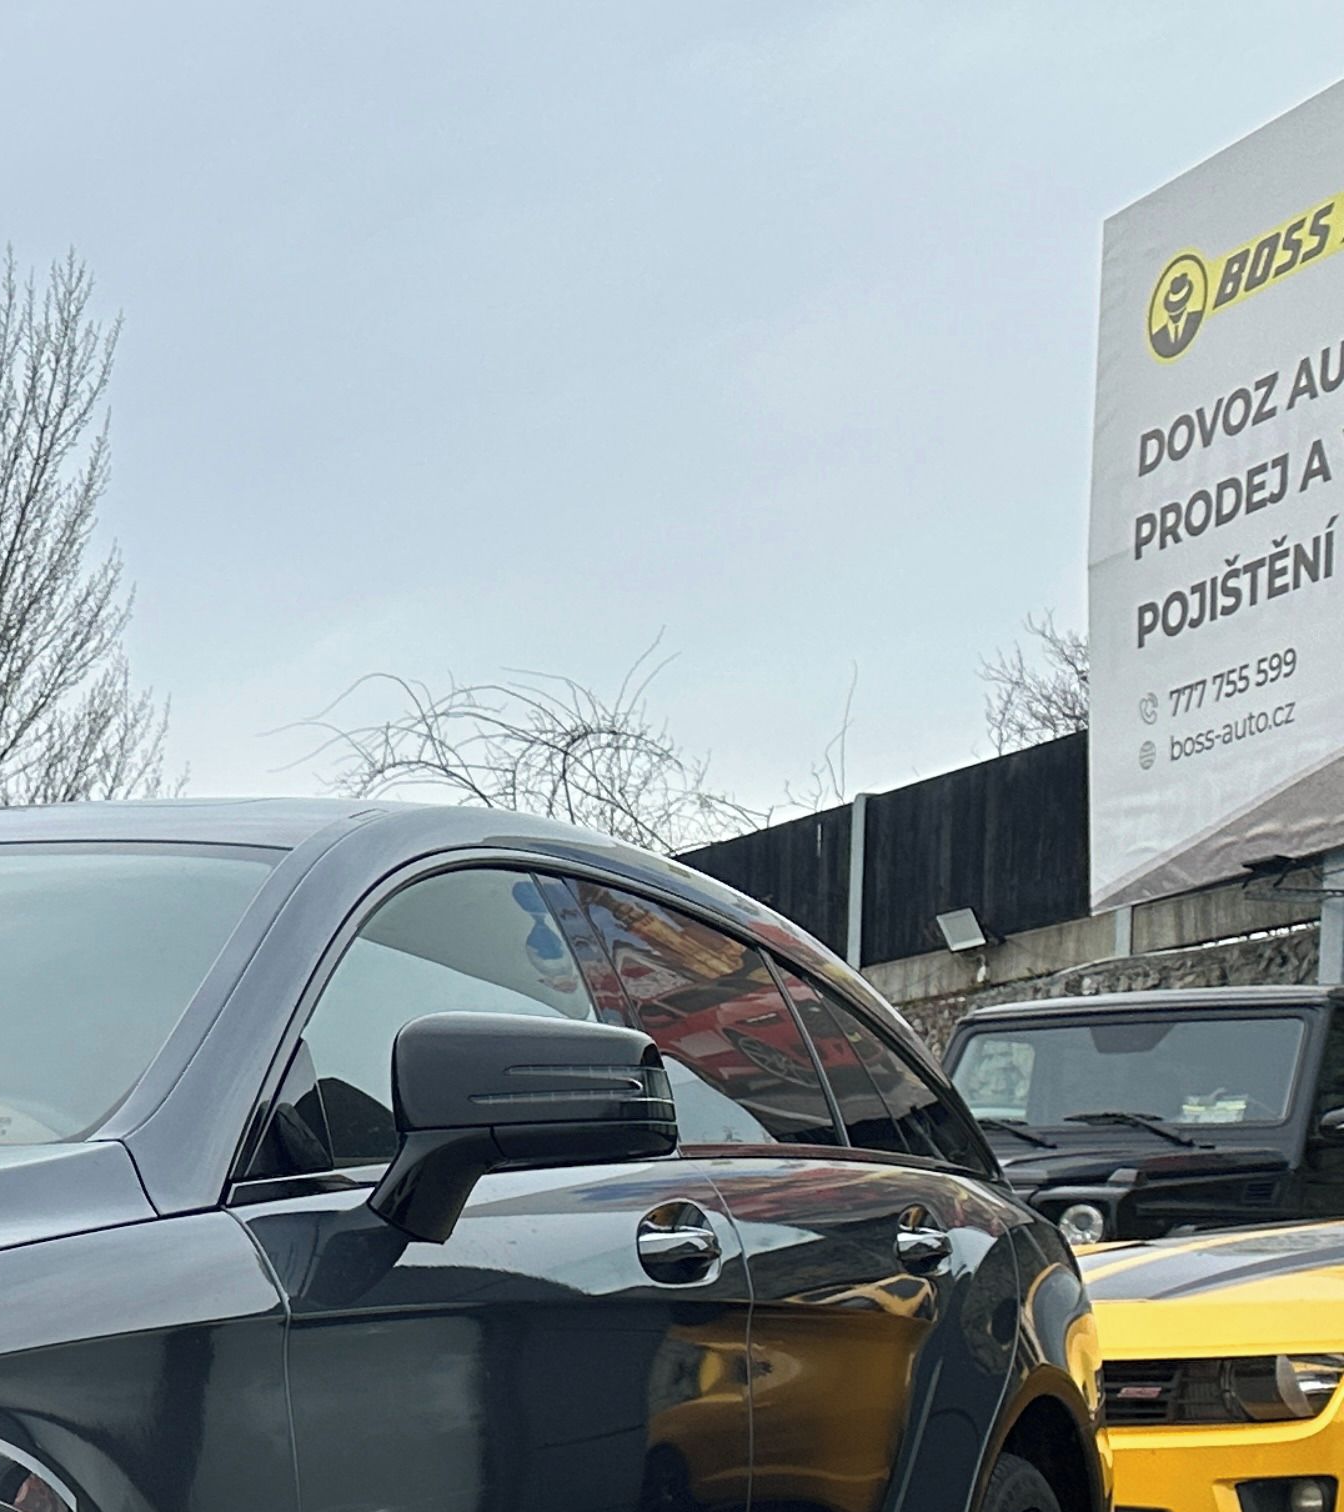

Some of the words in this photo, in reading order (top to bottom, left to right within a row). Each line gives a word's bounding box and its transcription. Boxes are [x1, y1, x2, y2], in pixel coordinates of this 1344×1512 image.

[1212, 201, 1335, 311] BOSS
[1138, 371, 1279, 477] DOVOZ
[1286, 339, 1344, 411] AU
[1134, 453, 1289, 560] PRODEJ
[1299, 439, 1332, 493] A
[1137, 514, 1339, 649] POJIŠTĚNÍ
[1169, 678, 1208, 718] 777
[1211, 663, 1250, 703] 755
[1254, 647, 1298, 687] 599
[1169, 700, 1296, 762] boss-auto.cz
